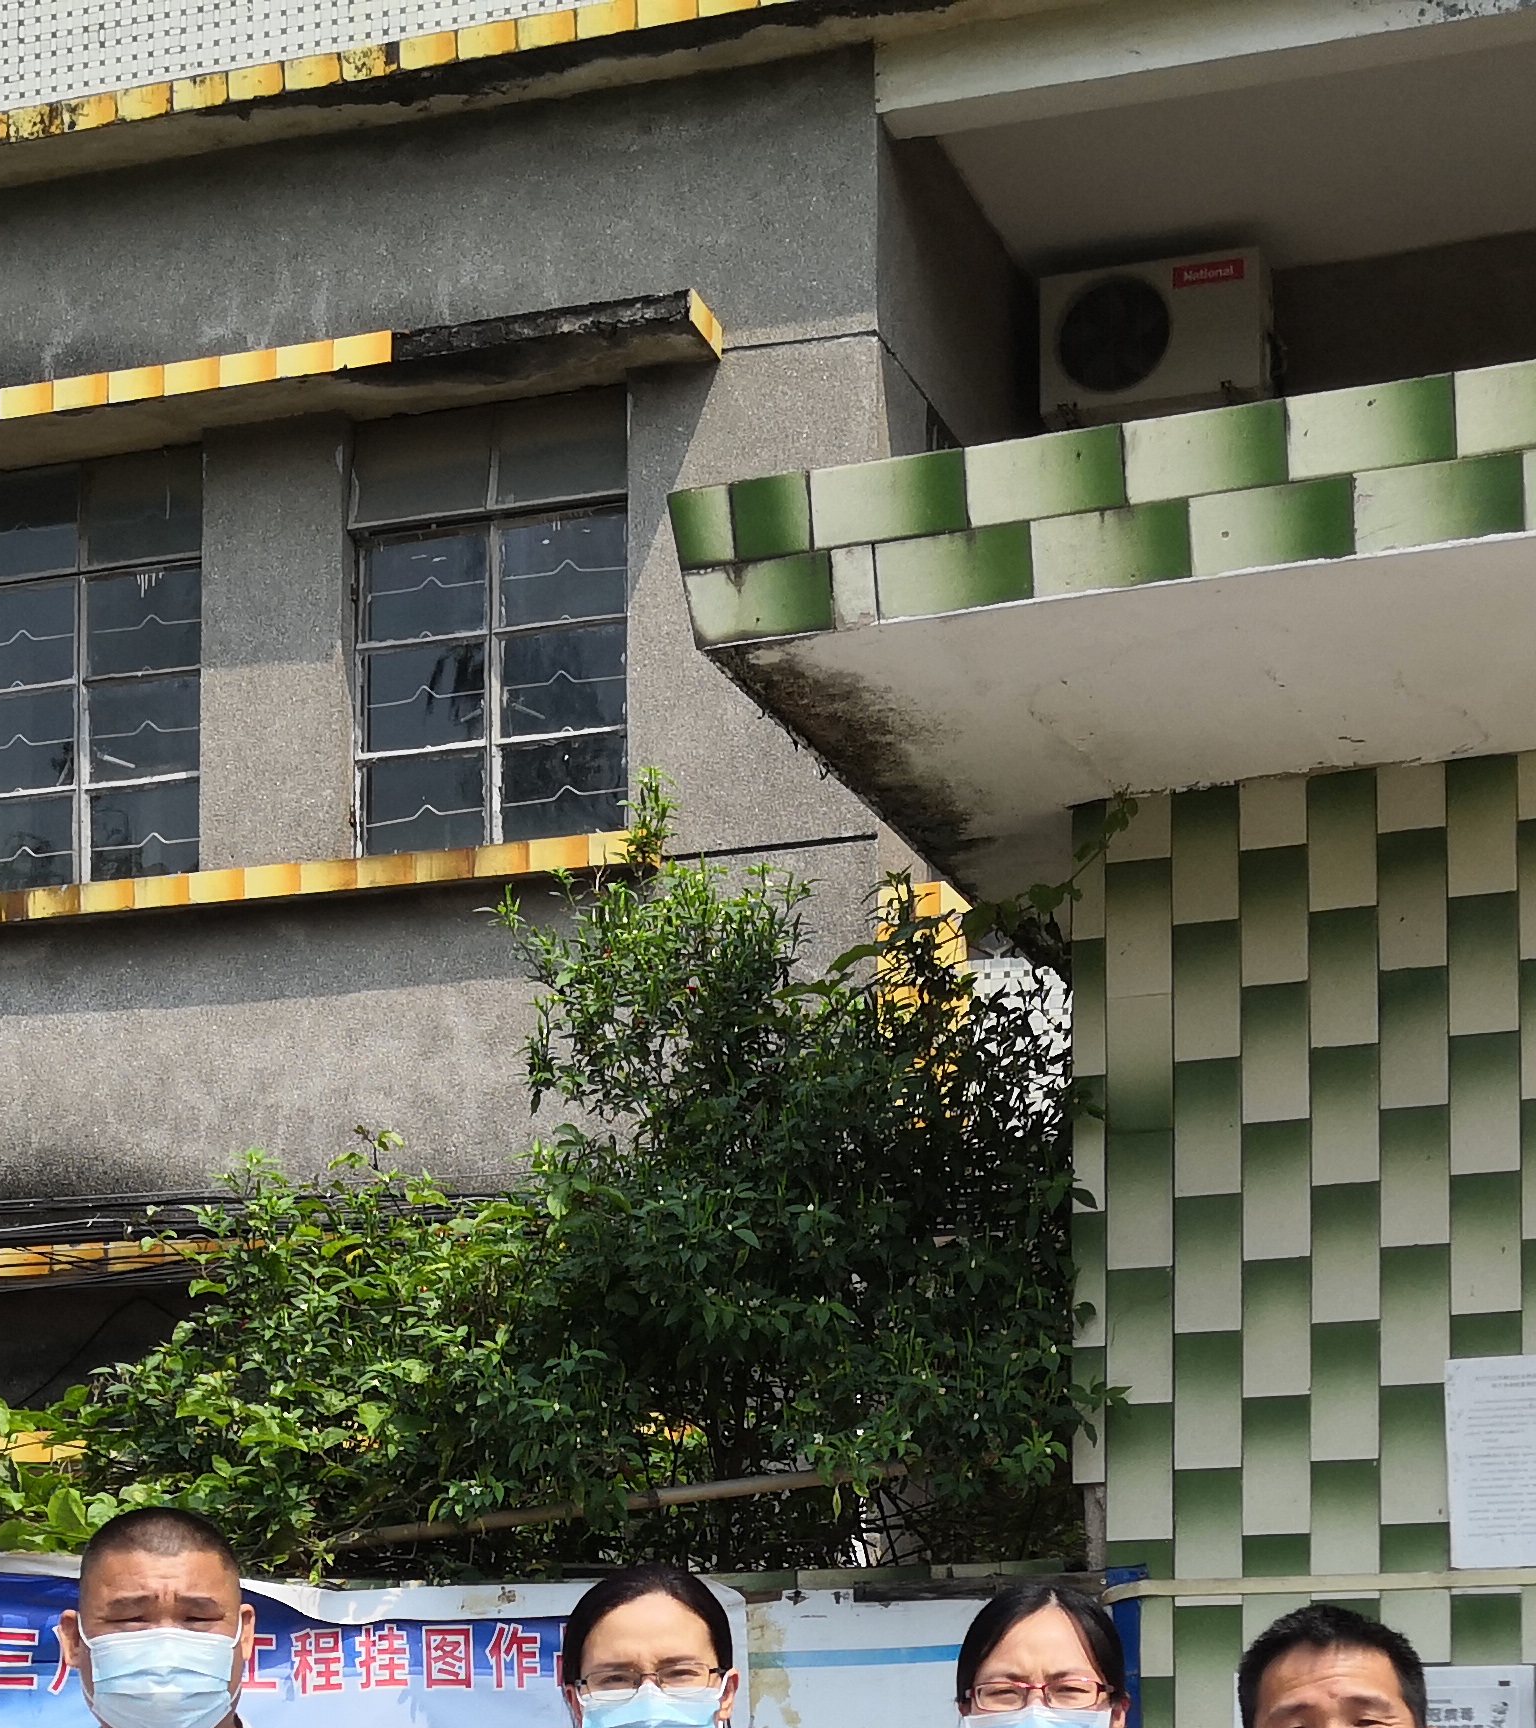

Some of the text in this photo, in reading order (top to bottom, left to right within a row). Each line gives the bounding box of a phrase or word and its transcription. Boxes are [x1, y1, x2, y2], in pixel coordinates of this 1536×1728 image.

[242, 1623, 563, 1692] 工程挂图作
